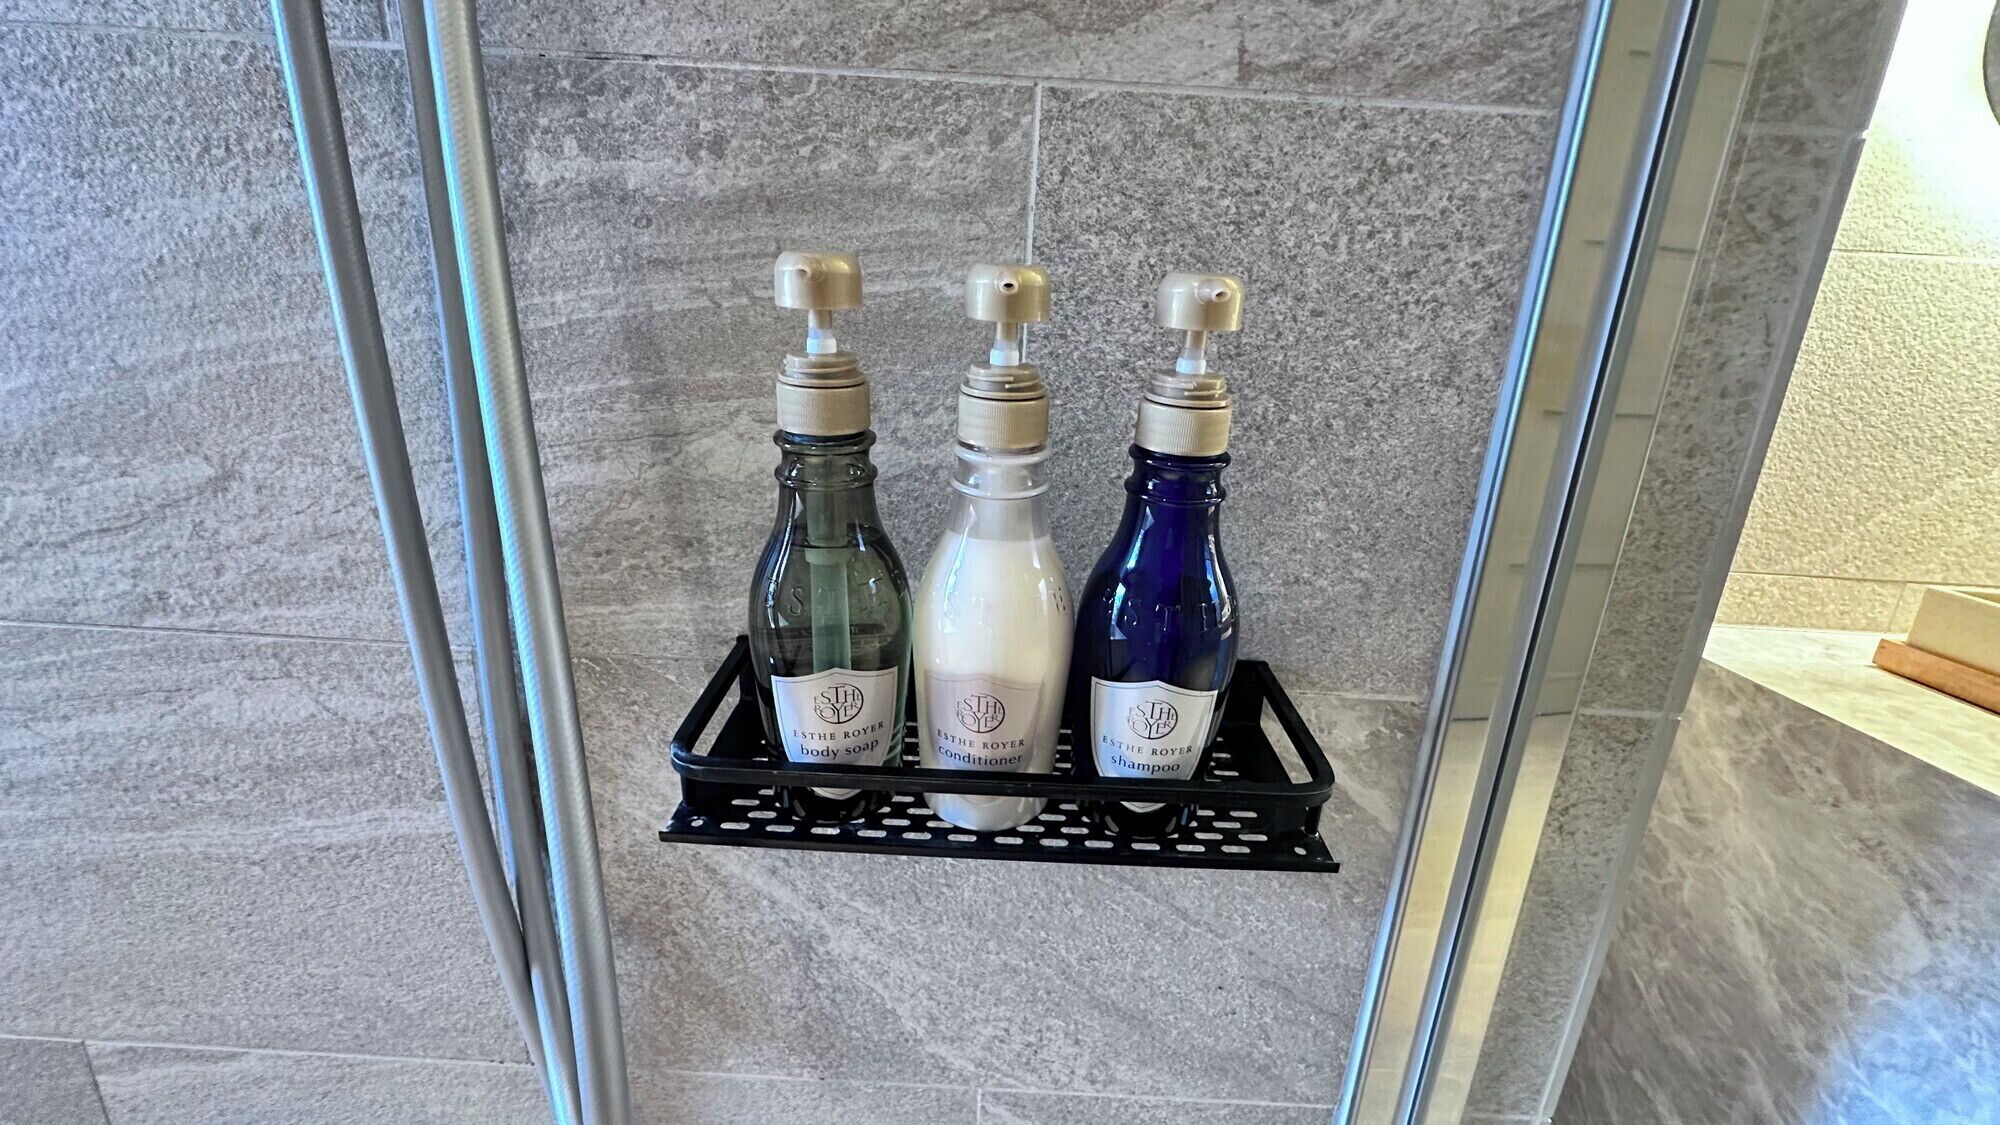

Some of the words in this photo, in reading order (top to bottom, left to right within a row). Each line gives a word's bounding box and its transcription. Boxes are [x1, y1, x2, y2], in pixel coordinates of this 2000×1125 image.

[793, 729, 837, 741] ESTHE
[843, 721, 885, 739] ROYER
[937, 729, 975, 748] ESTHE
[982, 739, 1025, 750] ROYER
[801, 744, 839, 759] body
[845, 739, 879, 755] soap
[1102, 735, 1144, 754] ESTHE
[1151, 745, 1193, 756] ROYER
[938, 746, 1024, 766] conditioner
[1111, 755, 1180, 775] shampoo
